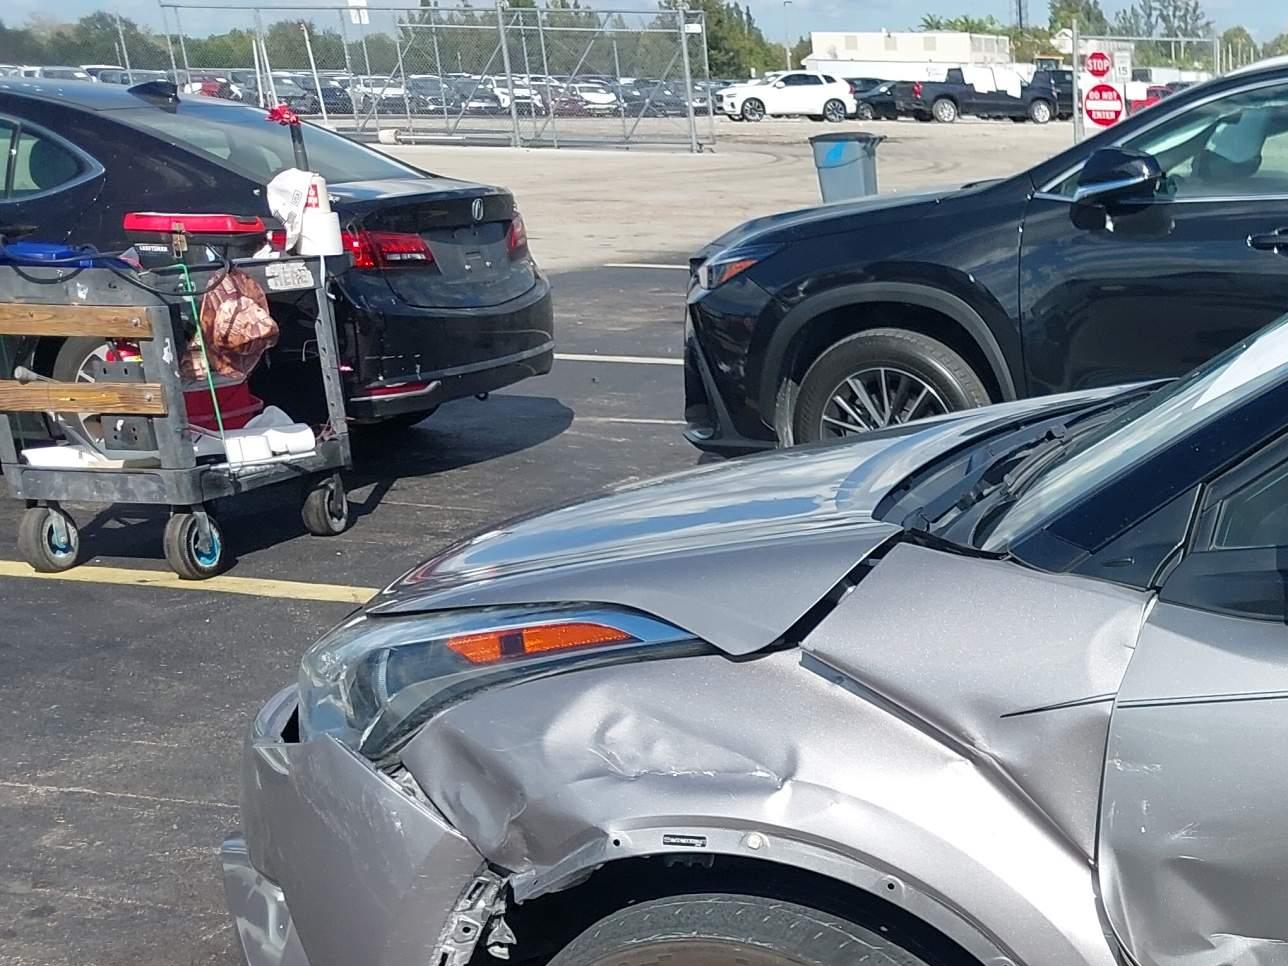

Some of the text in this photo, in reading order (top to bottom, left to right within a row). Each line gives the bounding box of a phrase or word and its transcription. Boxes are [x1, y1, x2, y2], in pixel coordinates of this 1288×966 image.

[1087, 58, 1109, 71] STOP
[1088, 90, 1117, 100] DO NOT
[1091, 110, 1116, 120] ENTER
